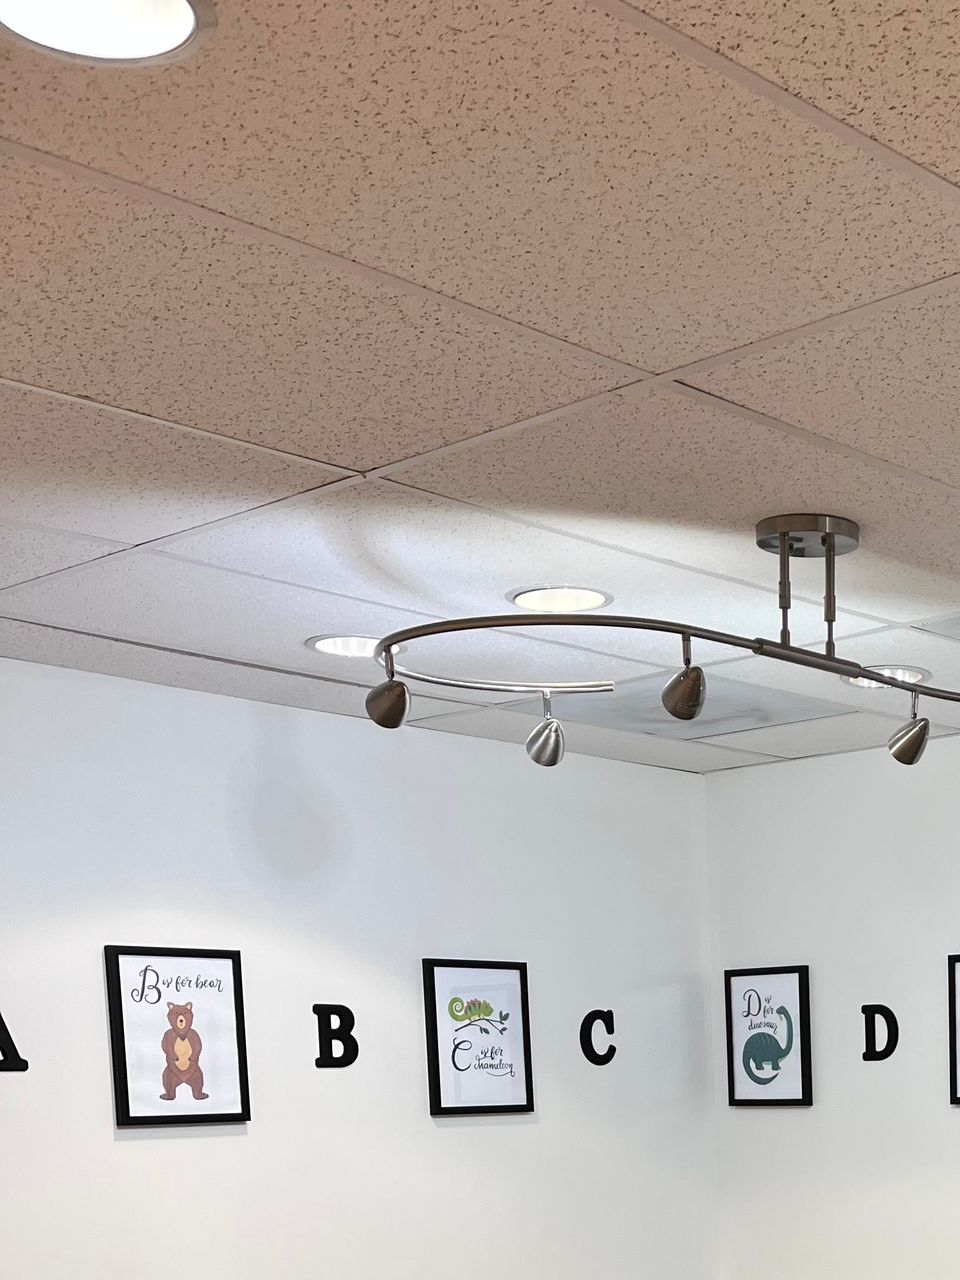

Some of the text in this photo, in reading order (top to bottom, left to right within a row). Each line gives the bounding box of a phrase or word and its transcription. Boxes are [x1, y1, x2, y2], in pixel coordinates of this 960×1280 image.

[131, 965, 224, 1005] B is for bear
[742, 988, 774, 1019] D is for
[312, 1003, 359, 1069] B
[579, 1009, 617, 1066] C
[748, 1018, 778, 1035] dinosaur
[861, 1004, 899, 1062] D
[451, 1037, 504, 1072] C is for
